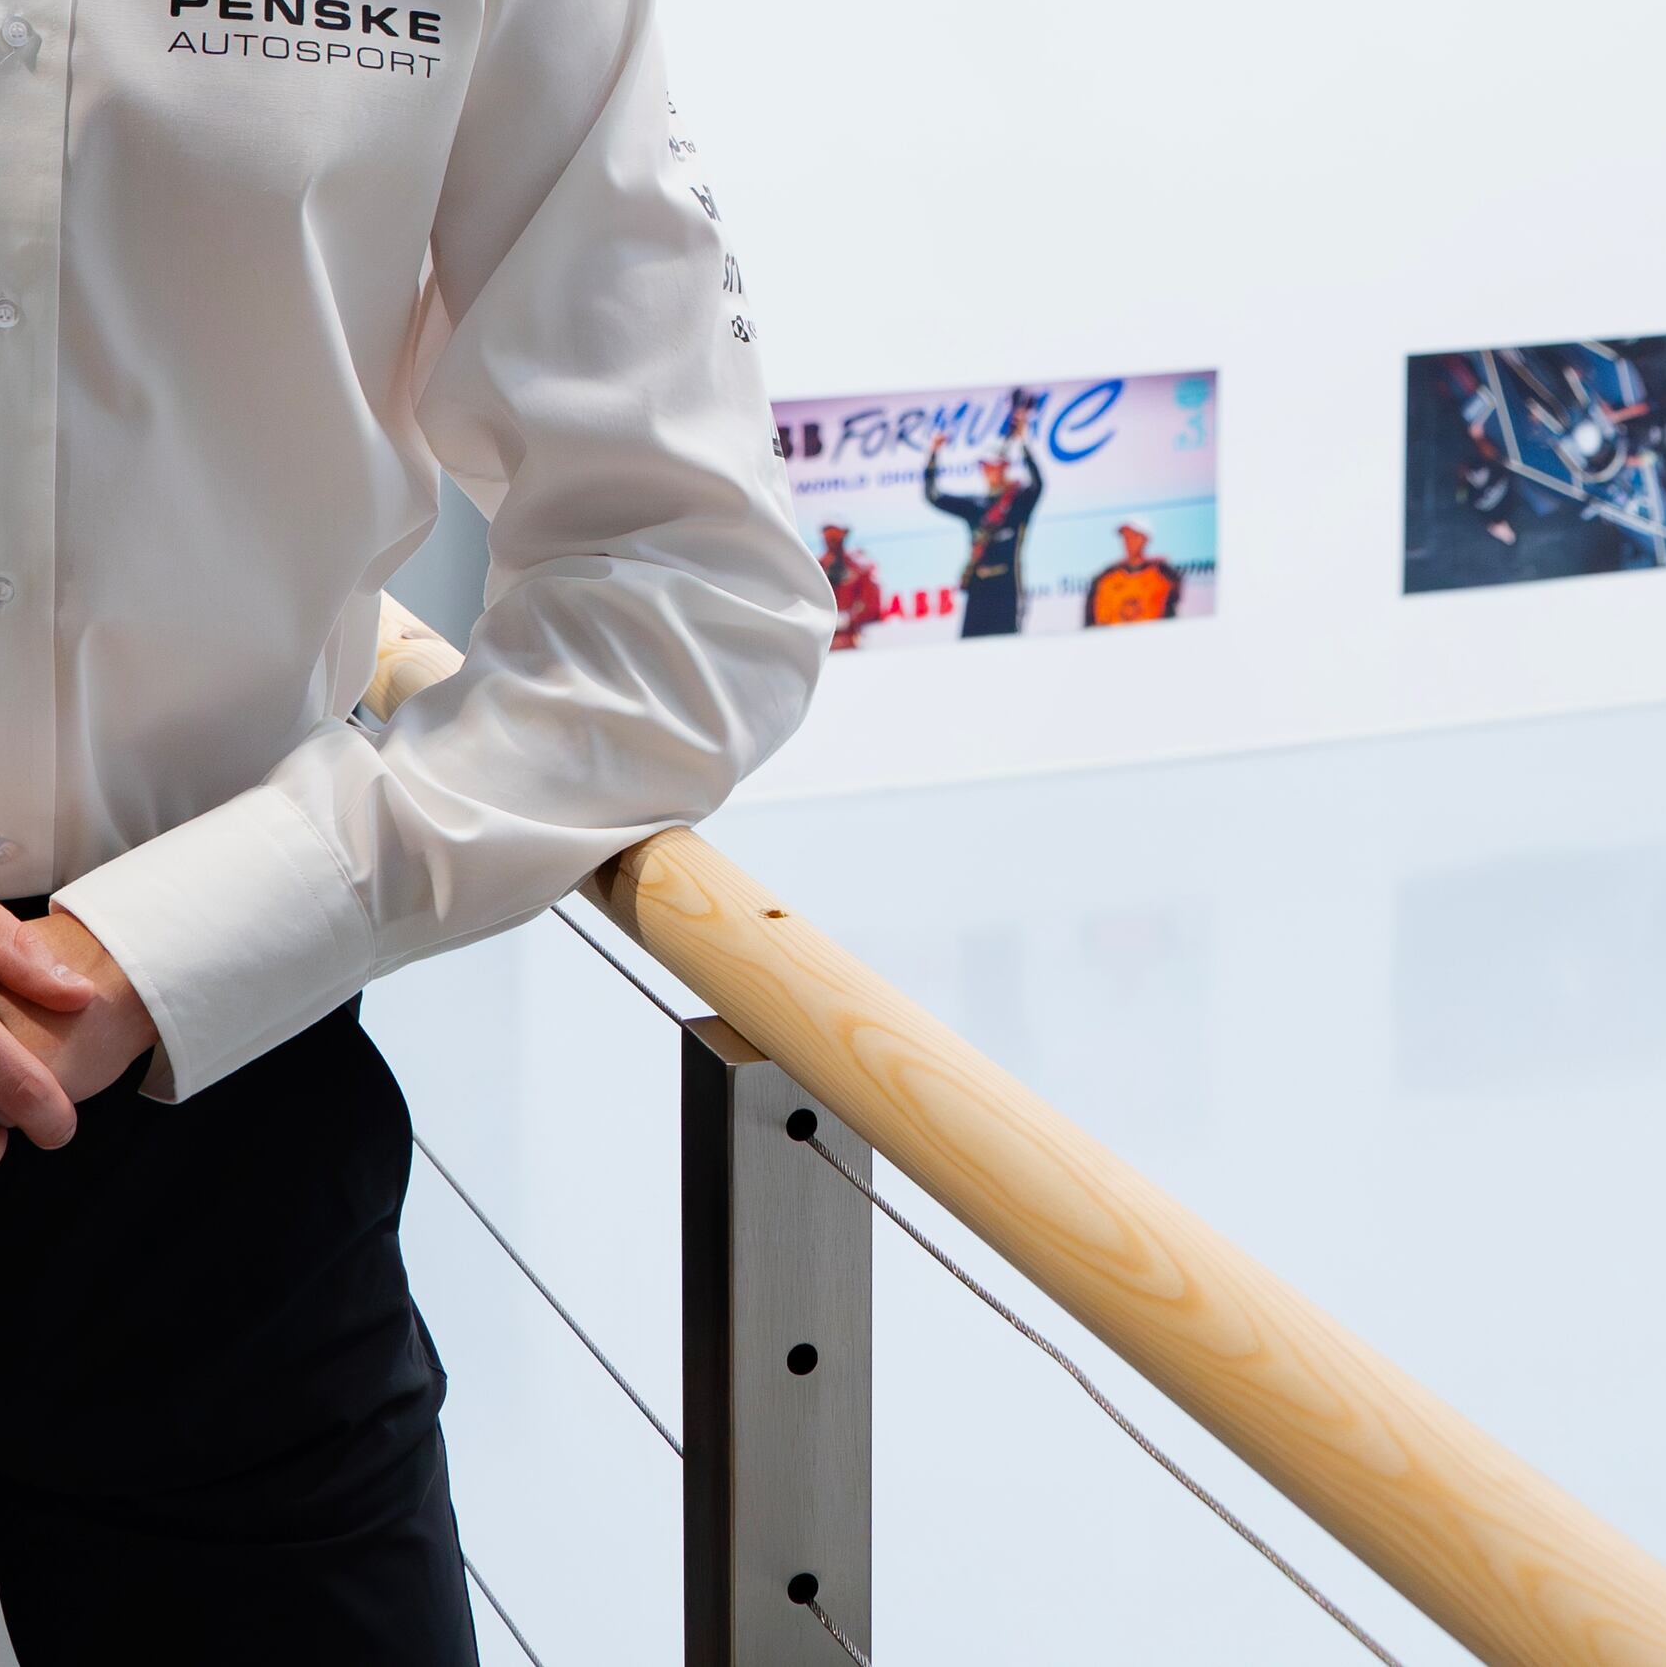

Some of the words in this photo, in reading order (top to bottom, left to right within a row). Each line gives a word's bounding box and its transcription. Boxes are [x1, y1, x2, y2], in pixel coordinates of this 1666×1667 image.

[168, 30, 442, 78] AUTOSPORT
[776, 422, 824, 461] BB
[884, 588, 955, 620] ABB
